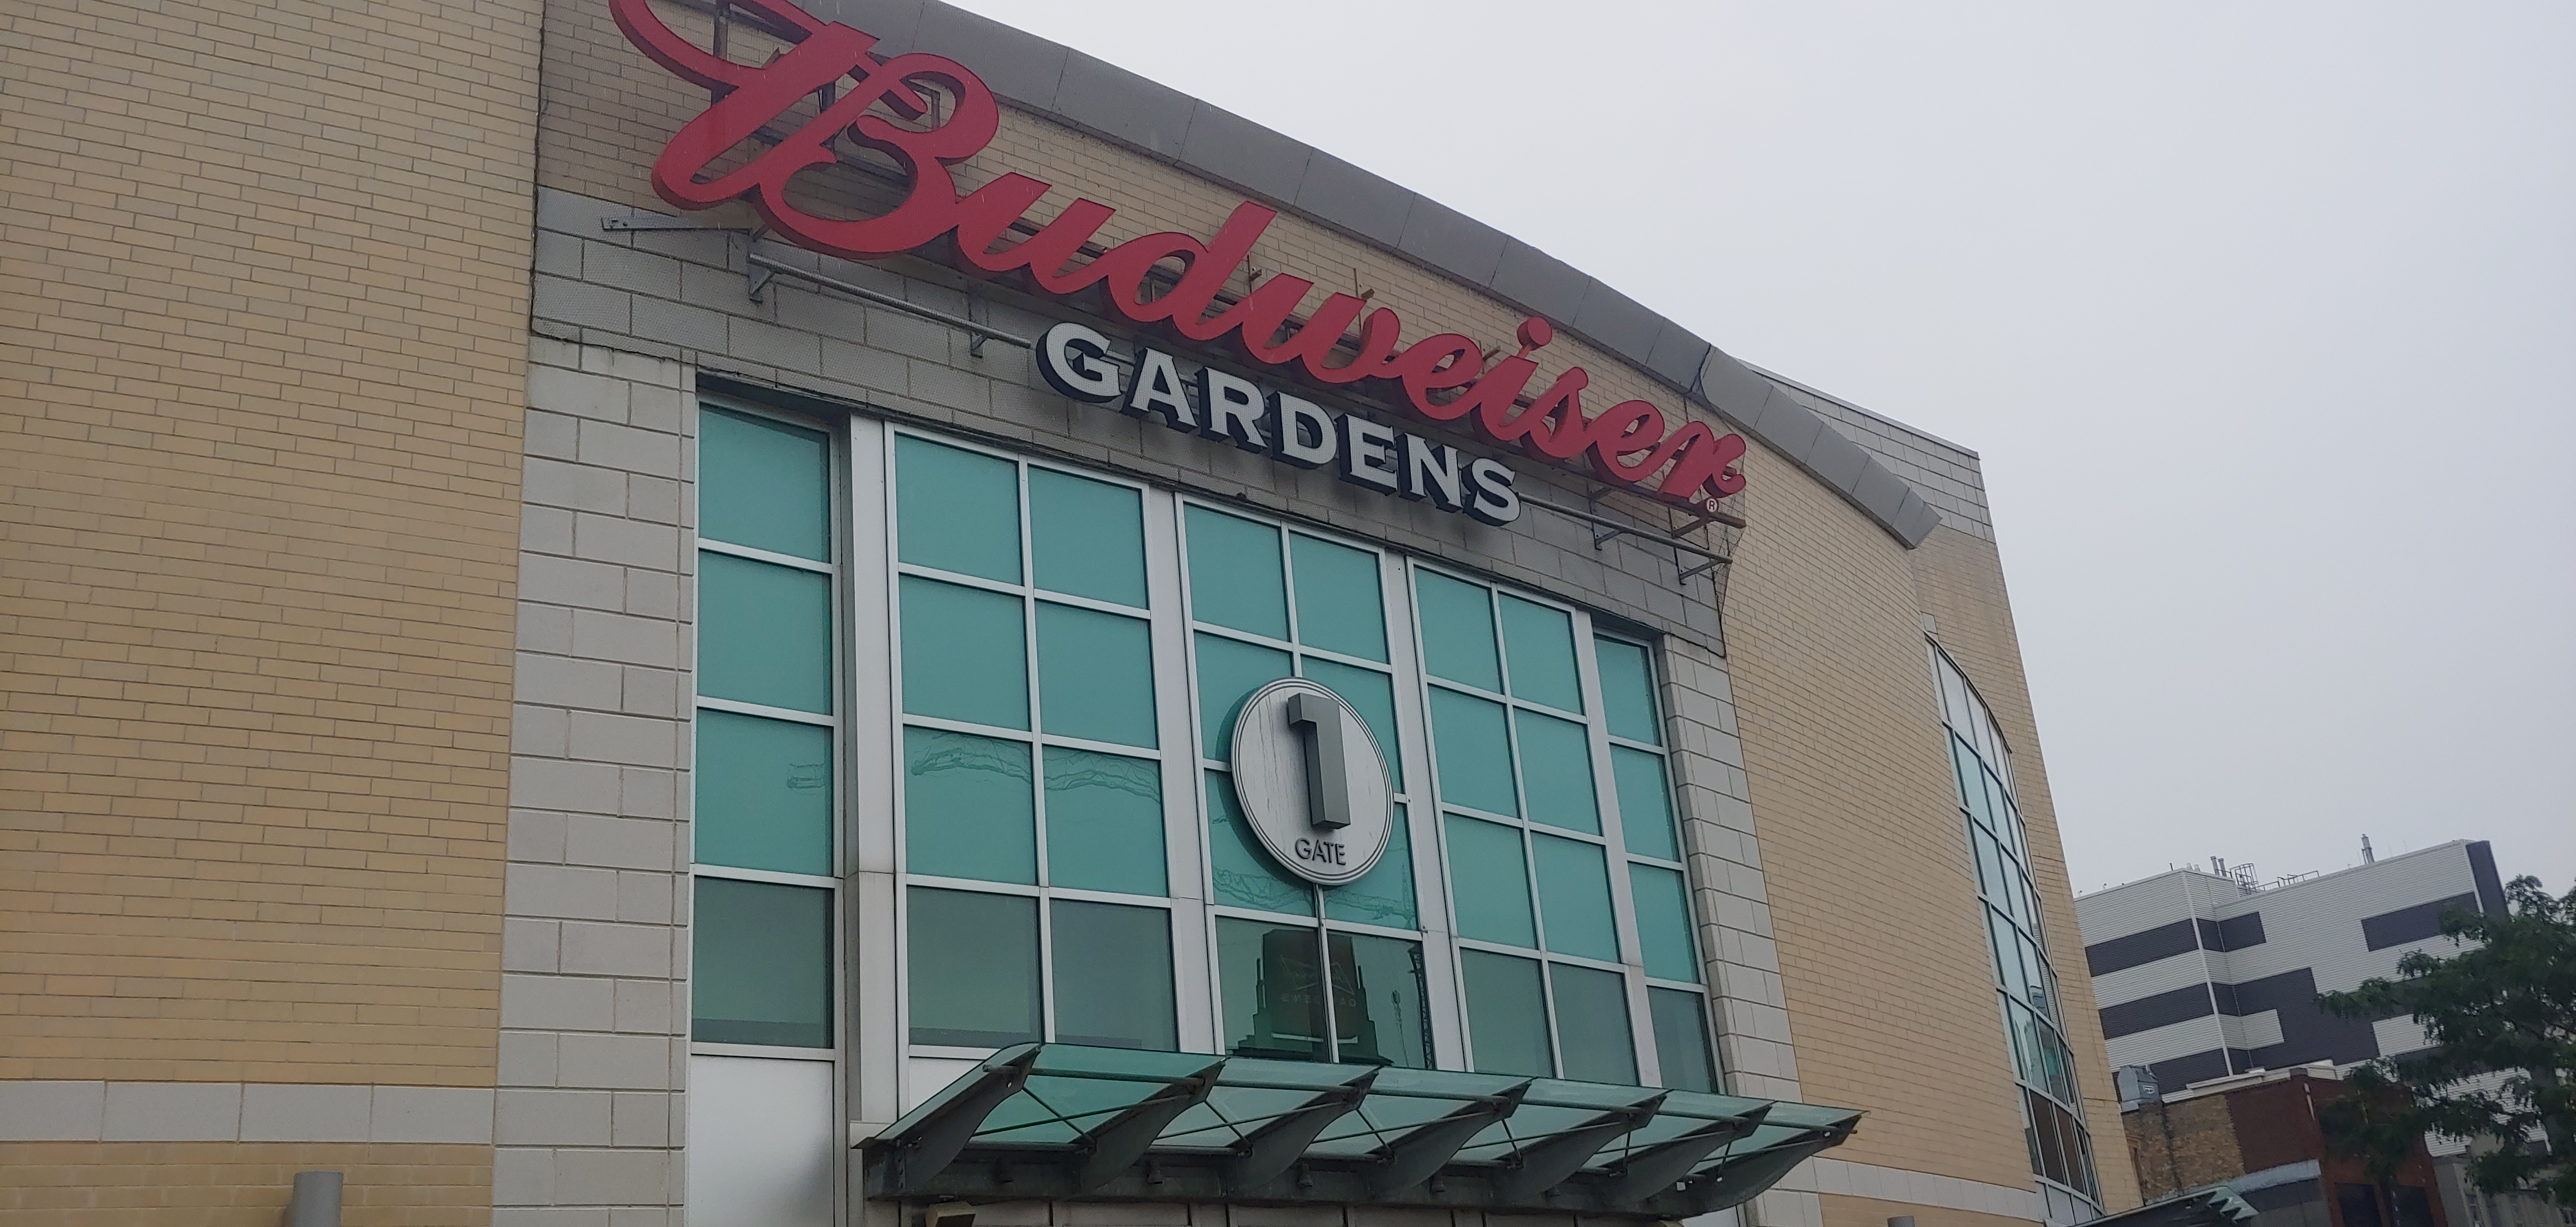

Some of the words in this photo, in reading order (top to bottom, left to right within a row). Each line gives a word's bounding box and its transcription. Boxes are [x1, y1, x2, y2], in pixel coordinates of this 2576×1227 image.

[609, 0, 1746, 498] Budweiser
[1036, 321, 1521, 527] GARDENS
[1287, 693, 1351, 830] 1
[1295, 838, 1347, 865] GATE
